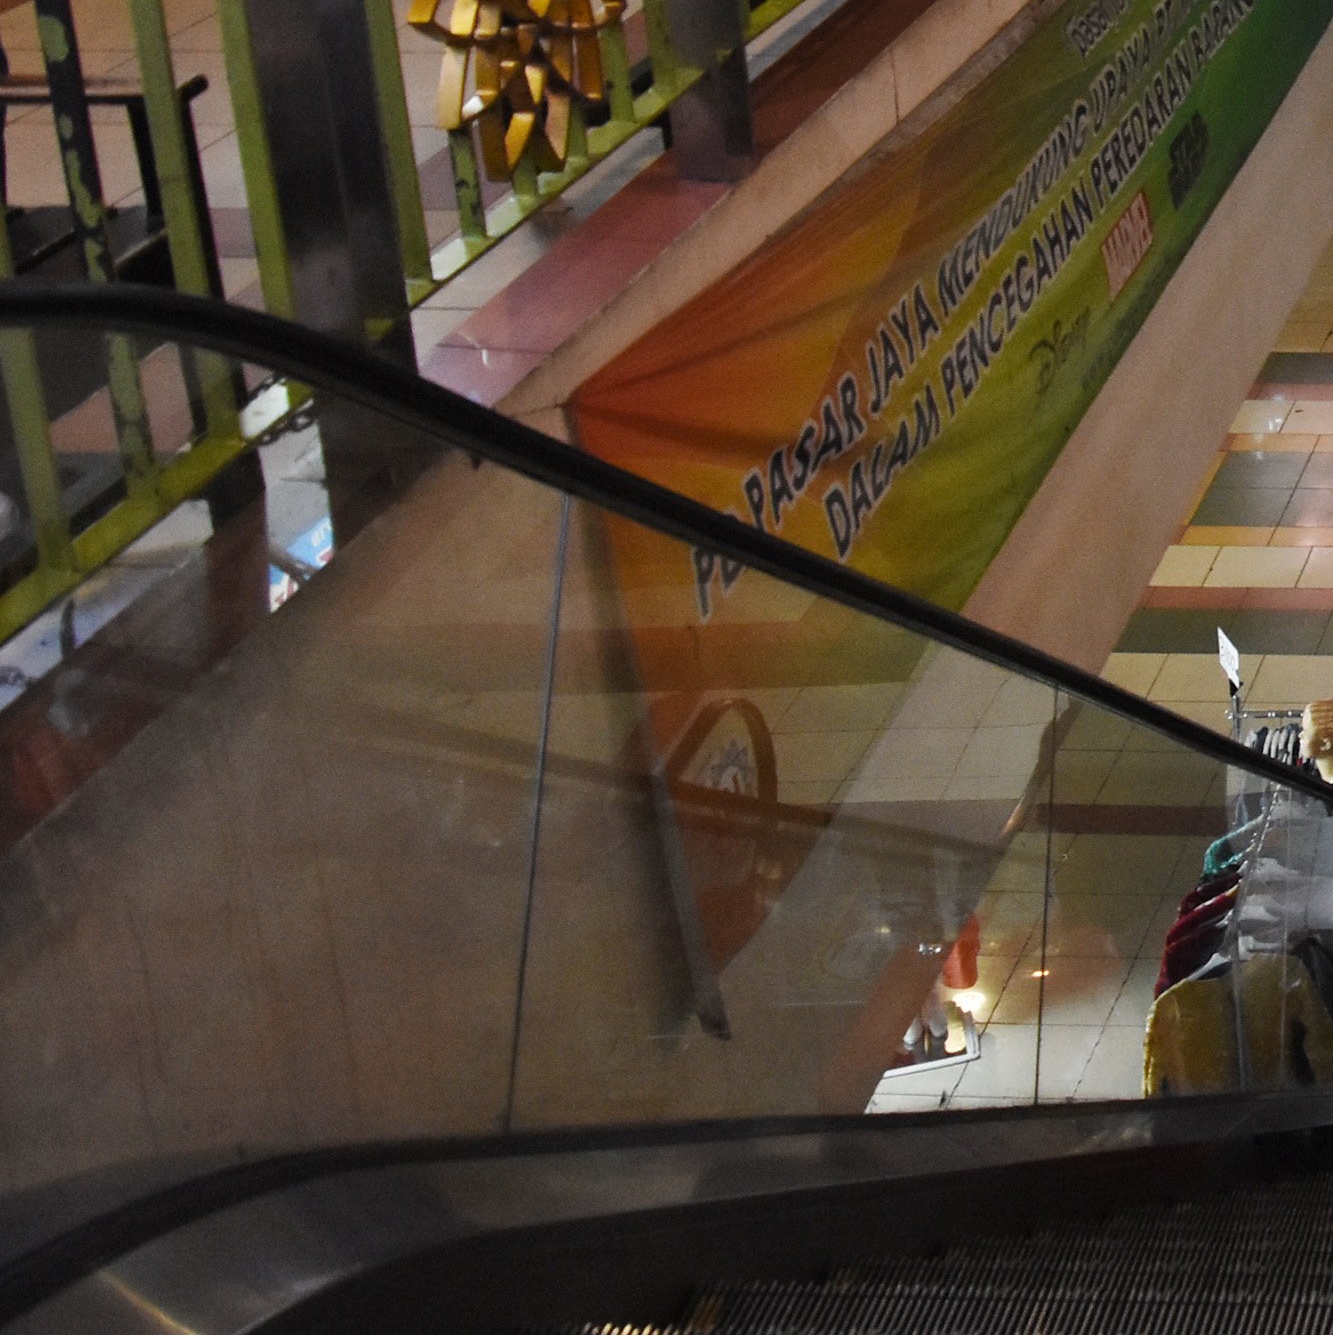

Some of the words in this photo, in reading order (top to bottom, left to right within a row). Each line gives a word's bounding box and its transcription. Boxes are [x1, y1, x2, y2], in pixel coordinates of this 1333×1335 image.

[743, 371, 867, 534] PASAR
[866, 277, 940, 419] JAYA
[936, 99, 1091, 318] MENDUKUNG
[822, 382, 941, 564] DALAM
[938, 174, 1096, 420] PENCEGAHAN
[1090, 39, 1195, 213] PEREDARAN
